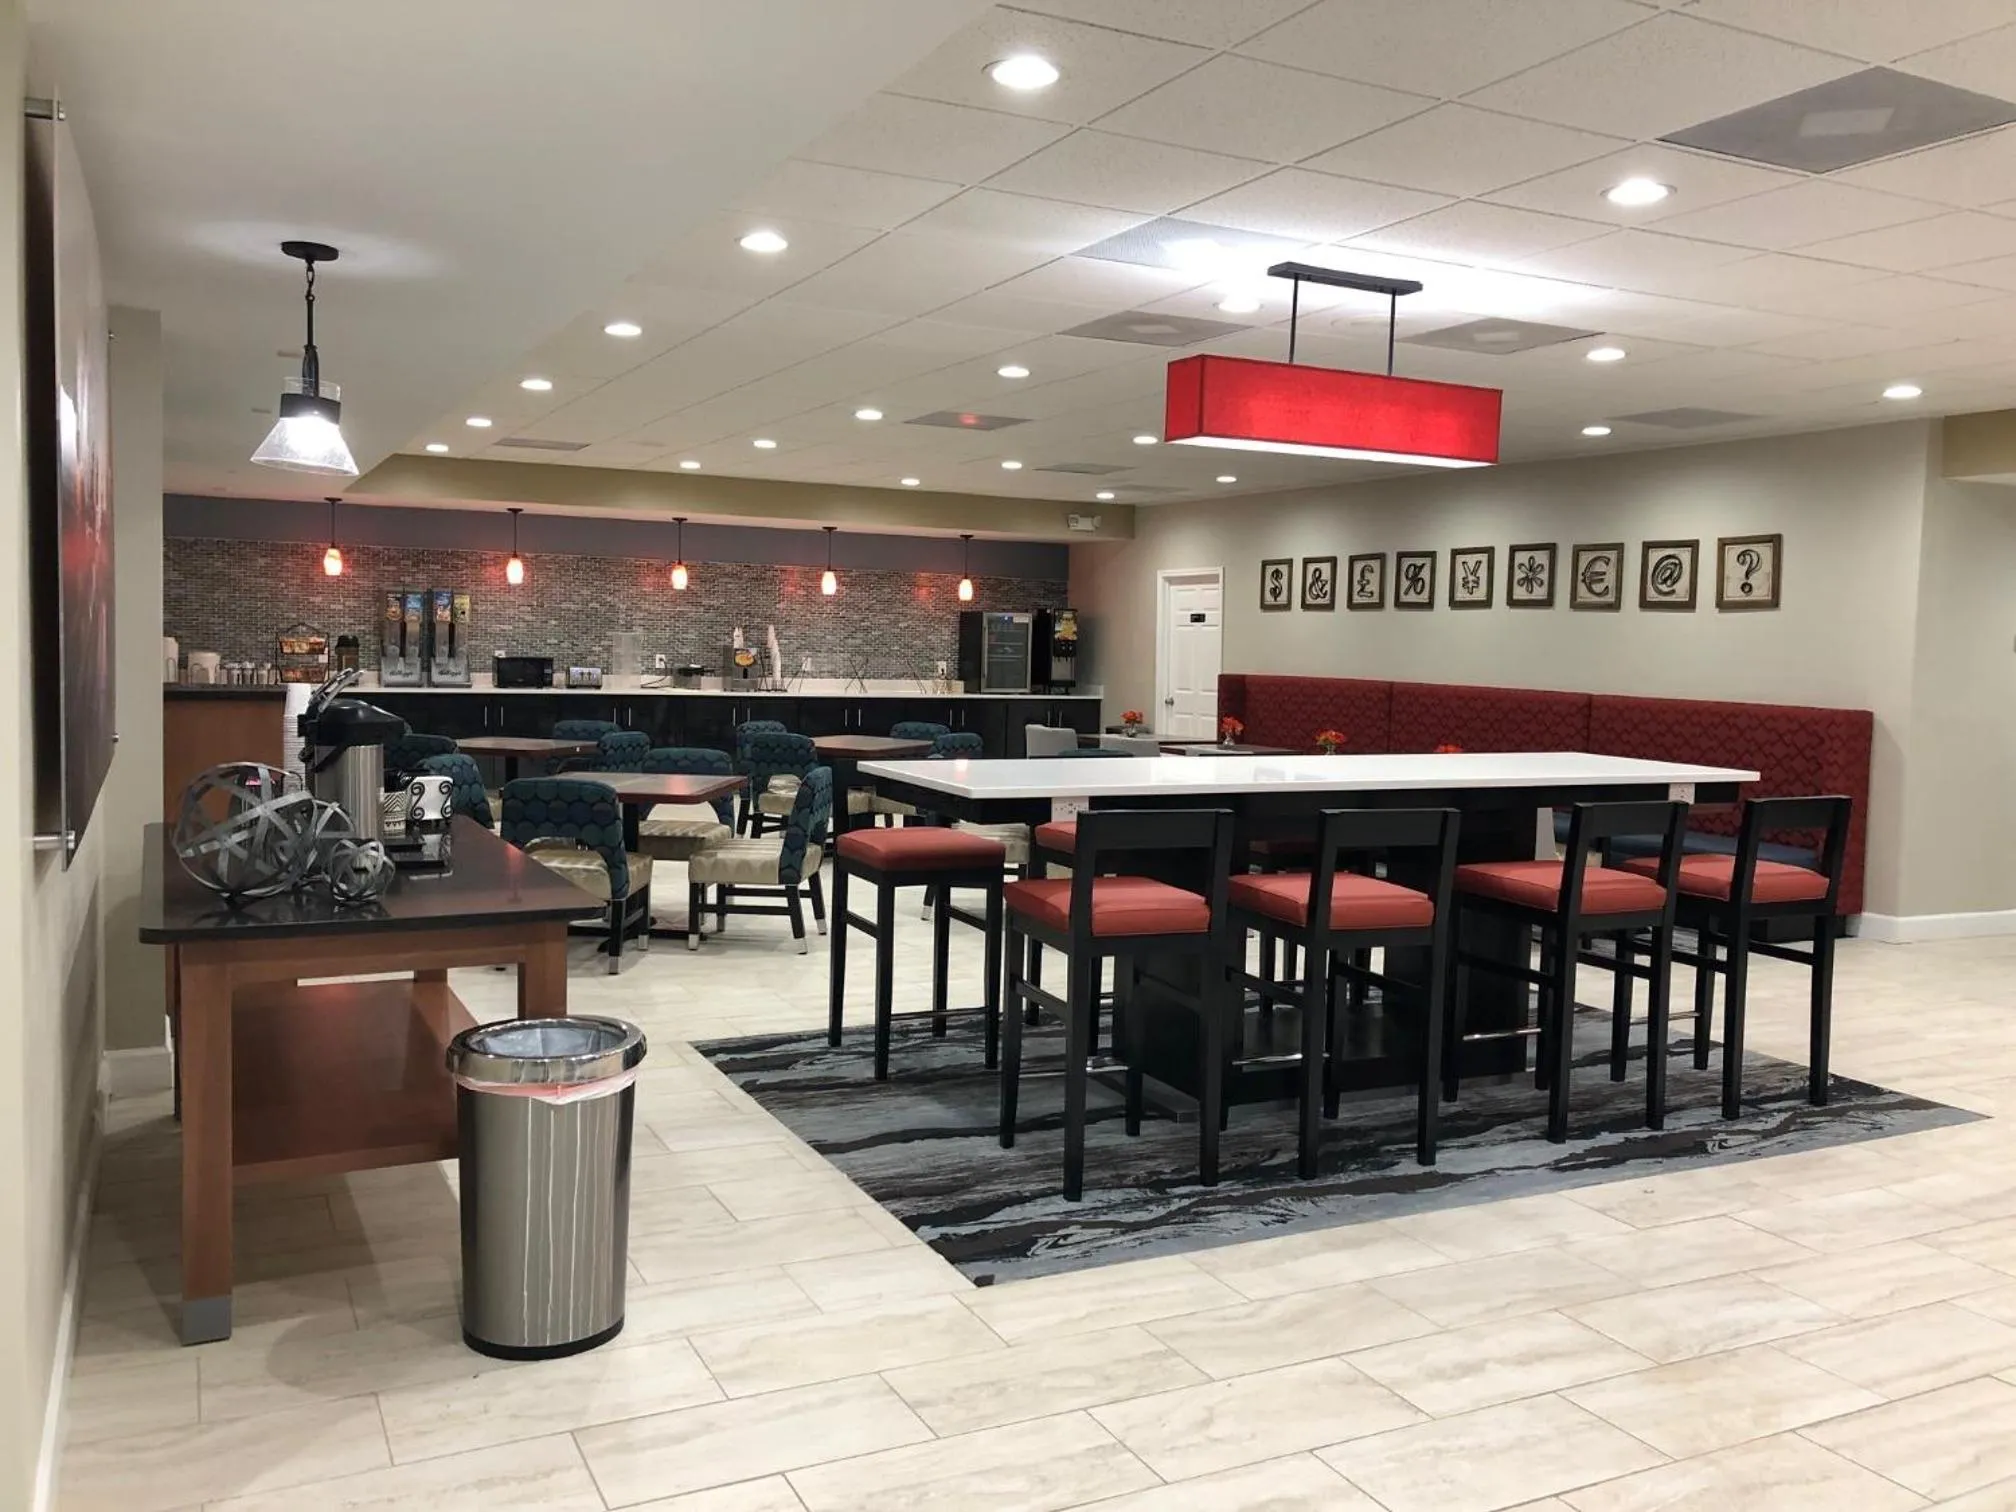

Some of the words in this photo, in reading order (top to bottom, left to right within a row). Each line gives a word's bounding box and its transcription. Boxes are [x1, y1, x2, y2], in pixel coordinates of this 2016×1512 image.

[1270, 567, 1283, 601] $
[1309, 567, 1328, 599] &
[1357, 564, 1374, 597] £
[1403, 562, 1426, 596] %
[1462, 560, 1482, 595] ¥
[1581, 555, 1610, 597] €
[1651, 554, 1683, 596] @
[1736, 549, 1761, 594] ?
